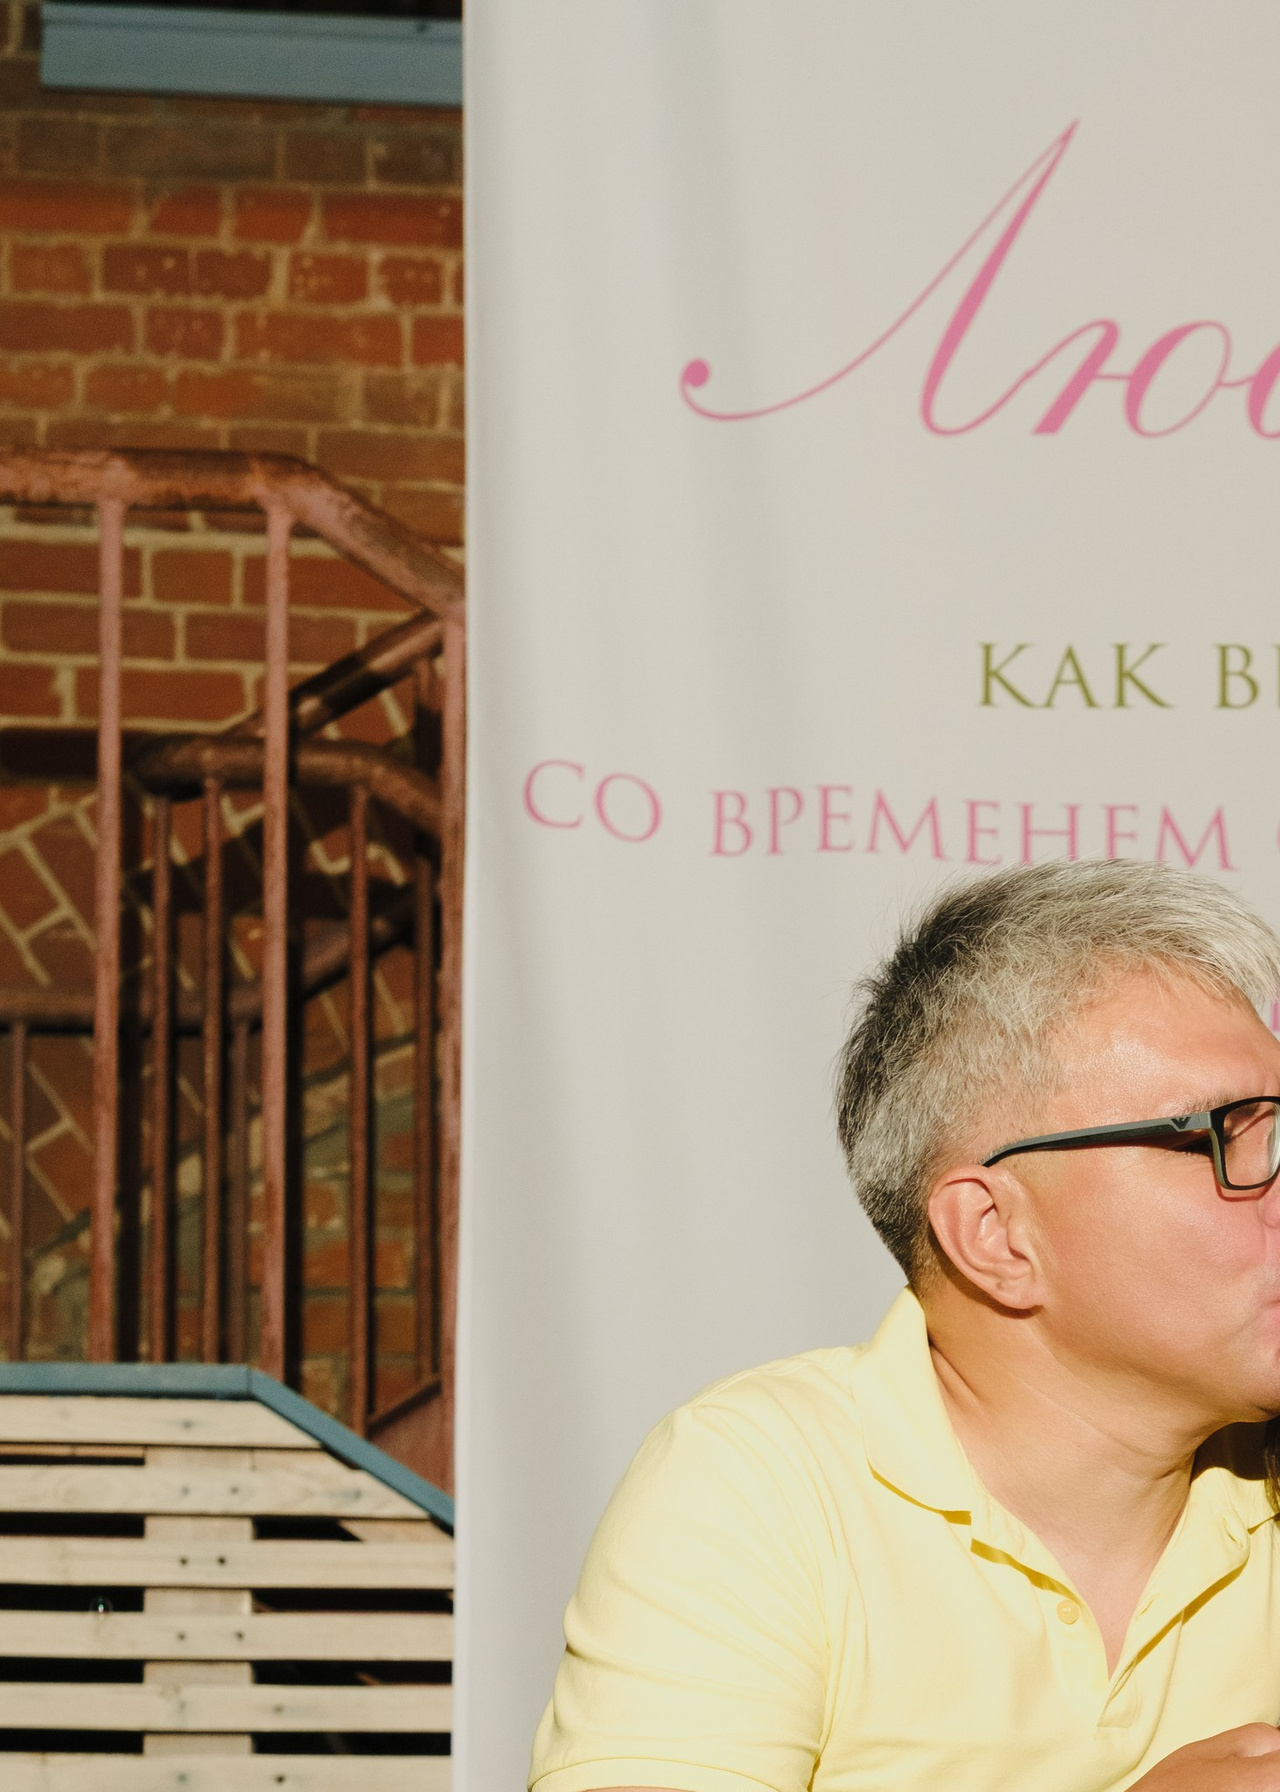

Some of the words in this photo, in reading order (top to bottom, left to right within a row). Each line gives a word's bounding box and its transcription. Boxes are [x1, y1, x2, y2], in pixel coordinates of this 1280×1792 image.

[976, 641, 1172, 711] КАК
[520, 758, 663, 843] СО
[709, 783, 1239, 872] ВРЕМЕНЕМ
